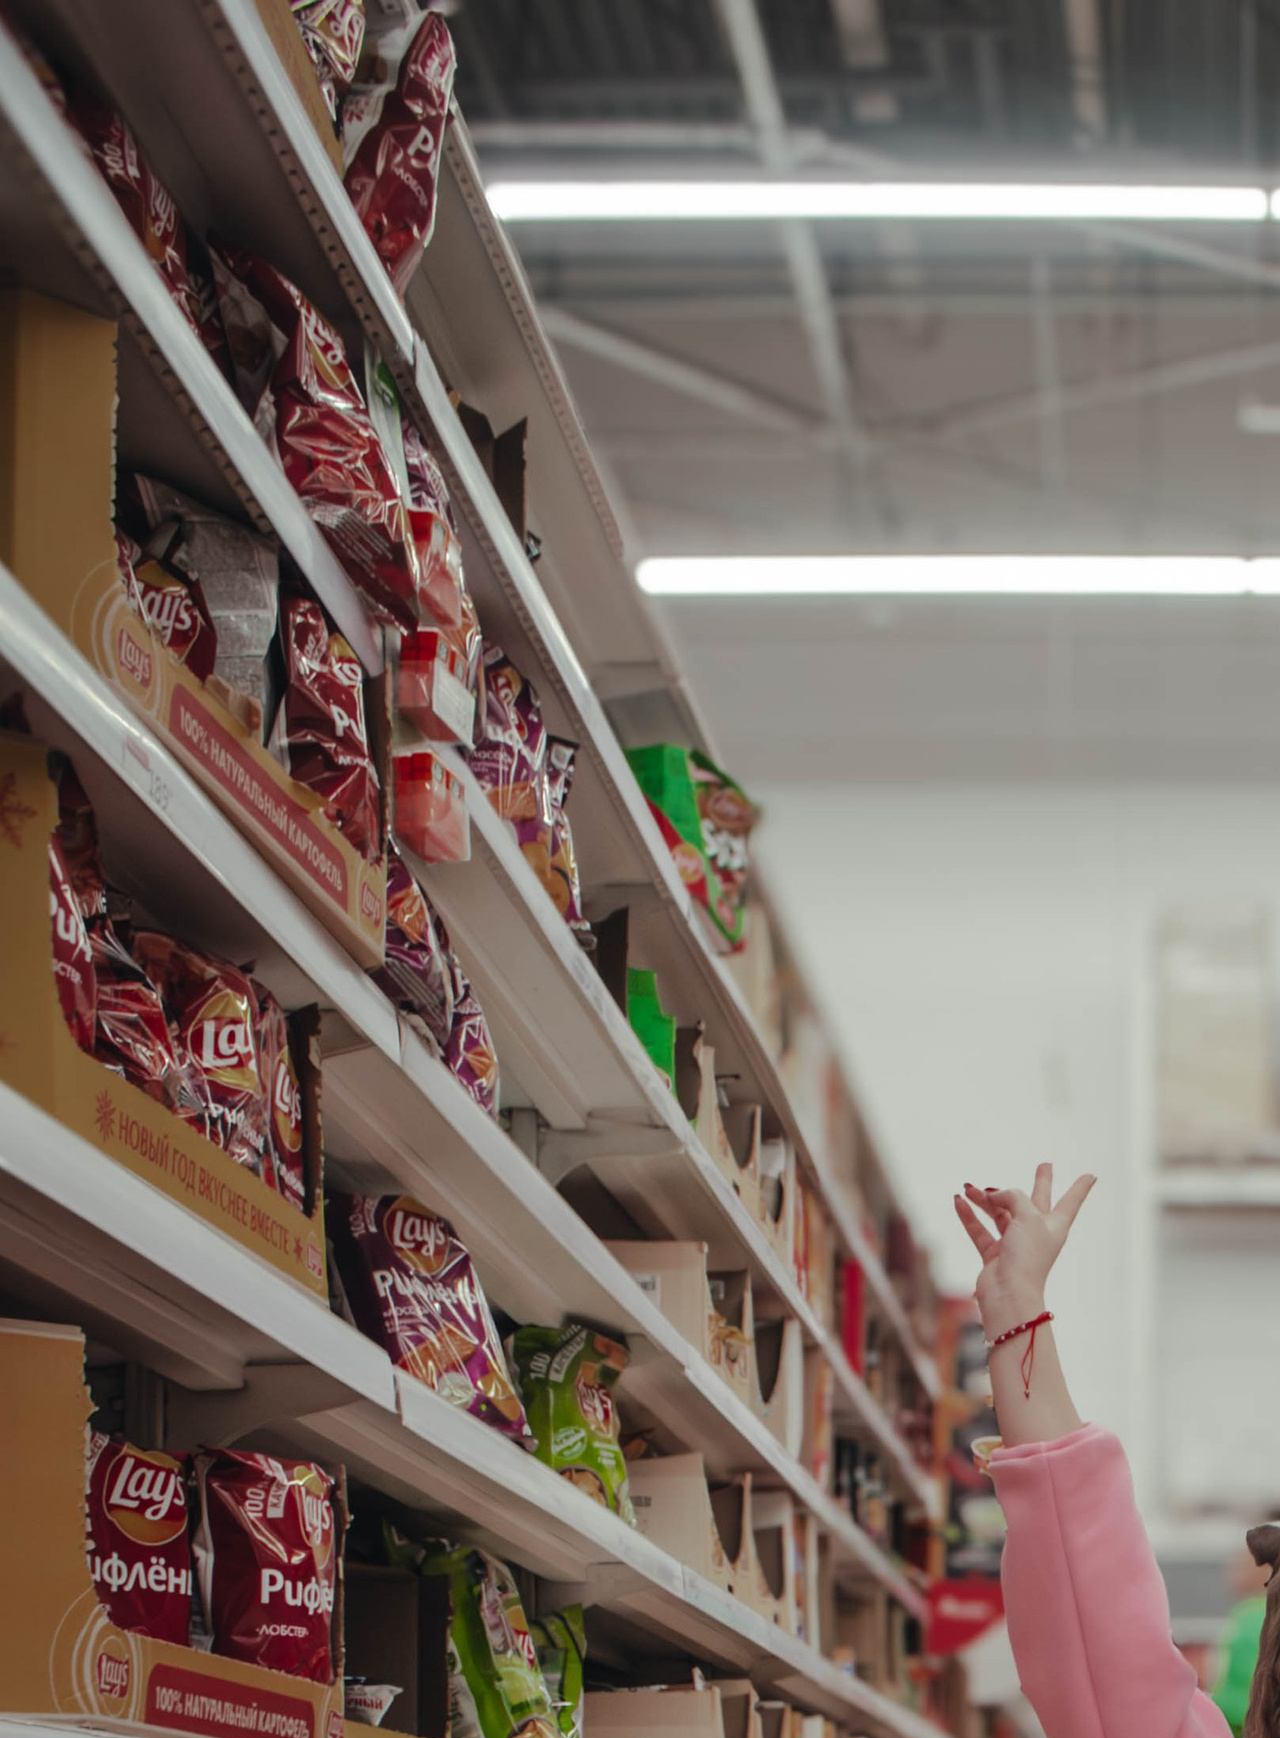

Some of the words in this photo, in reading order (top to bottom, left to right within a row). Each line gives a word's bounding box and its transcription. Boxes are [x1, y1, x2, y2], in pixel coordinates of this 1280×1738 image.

[179, 705, 208, 755] 100%
[210, 740, 288, 833] НАТУРАЛЬНЫЙ
[288, 820, 343, 890] КАРТОФЕЛЬ
[119, 1112, 169, 1174] НОВЫЙ
[171, 1152, 196, 1197] ГОД
[199, 1168, 249, 1228] ВКУСНЕЕ
[250, 1204, 290, 1255] ВМЕСТЕ
[155, 1685, 182, 1715] 100%
[184, 1692, 257, 1729] НАТУРАЛЬНЫЙ
